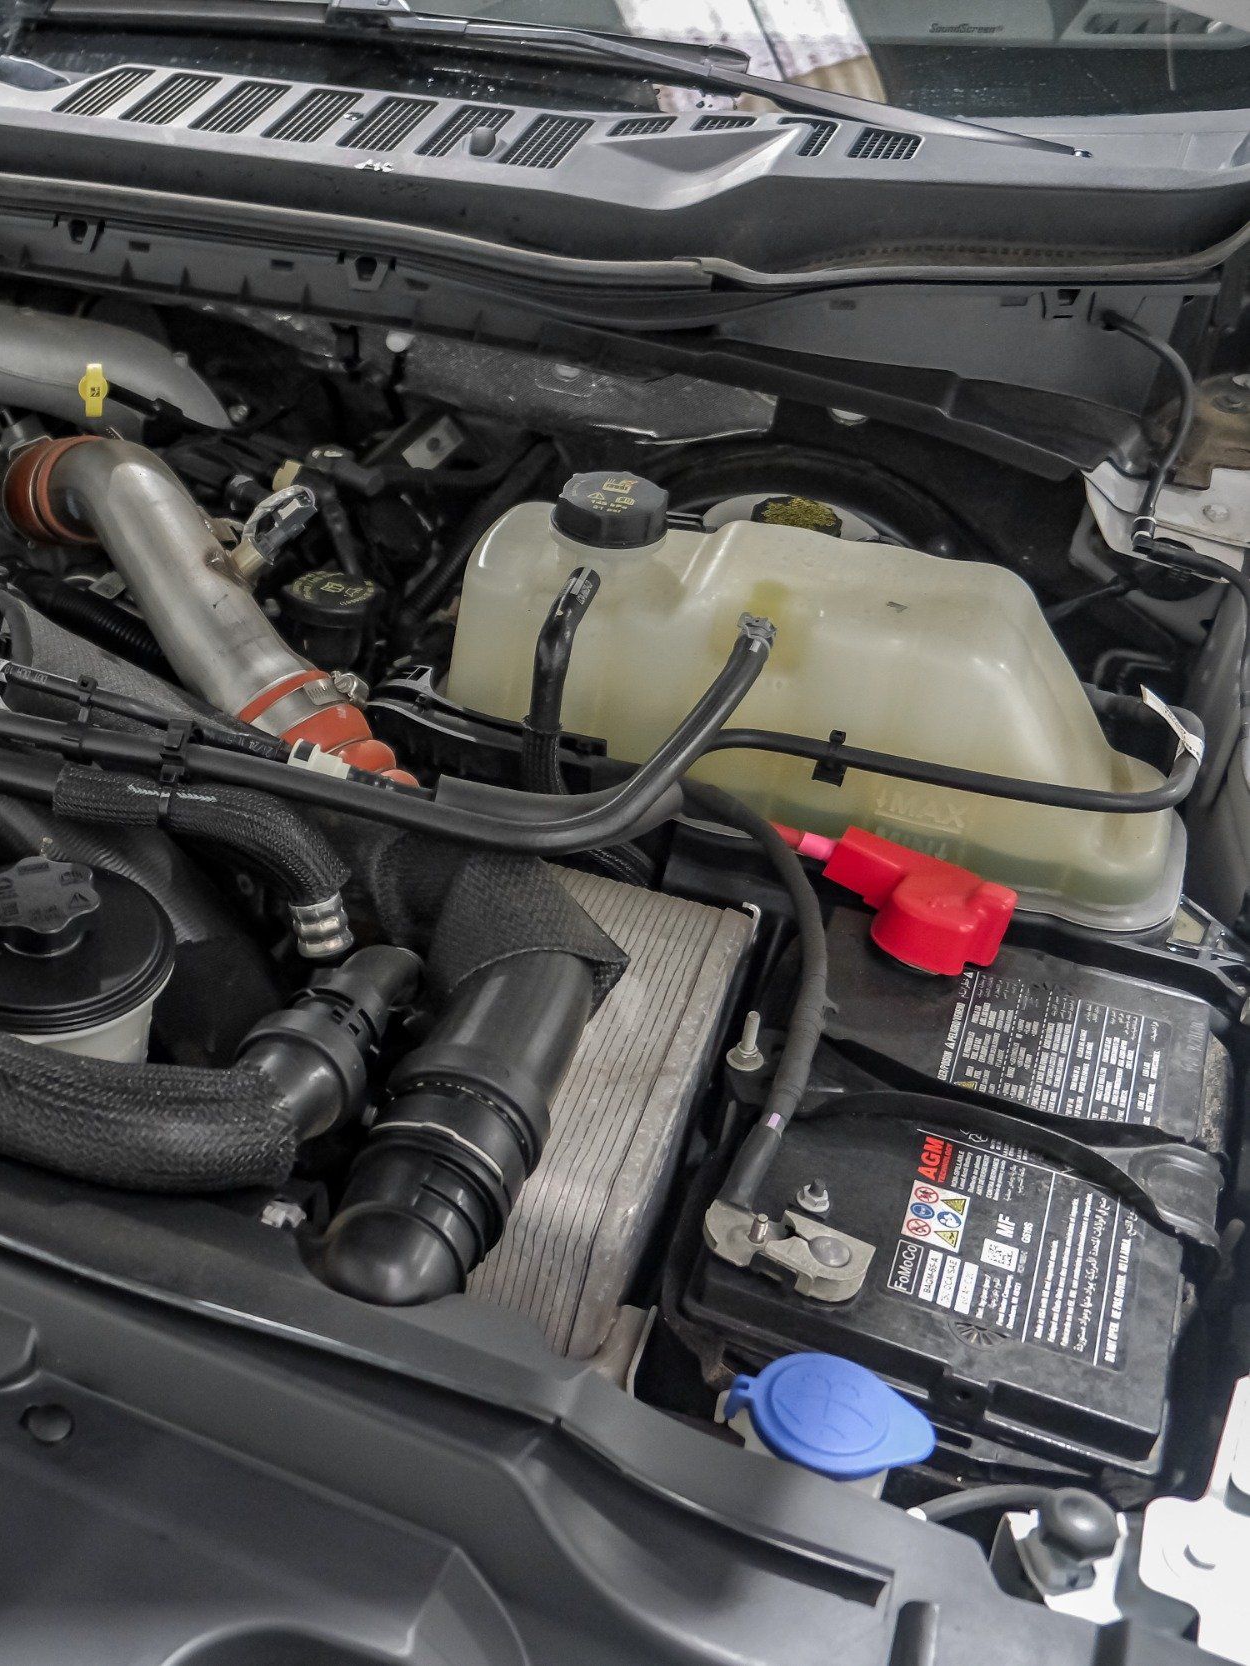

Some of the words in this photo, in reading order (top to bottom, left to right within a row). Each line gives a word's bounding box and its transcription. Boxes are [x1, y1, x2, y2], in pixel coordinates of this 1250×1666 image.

[917, 1136, 946, 1181] AGM
[937, 1143, 954, 1183] TECHNOLOGY
[996, 1214, 1015, 1238] MF
[894, 1243, 917, 1291] FoMoCo
